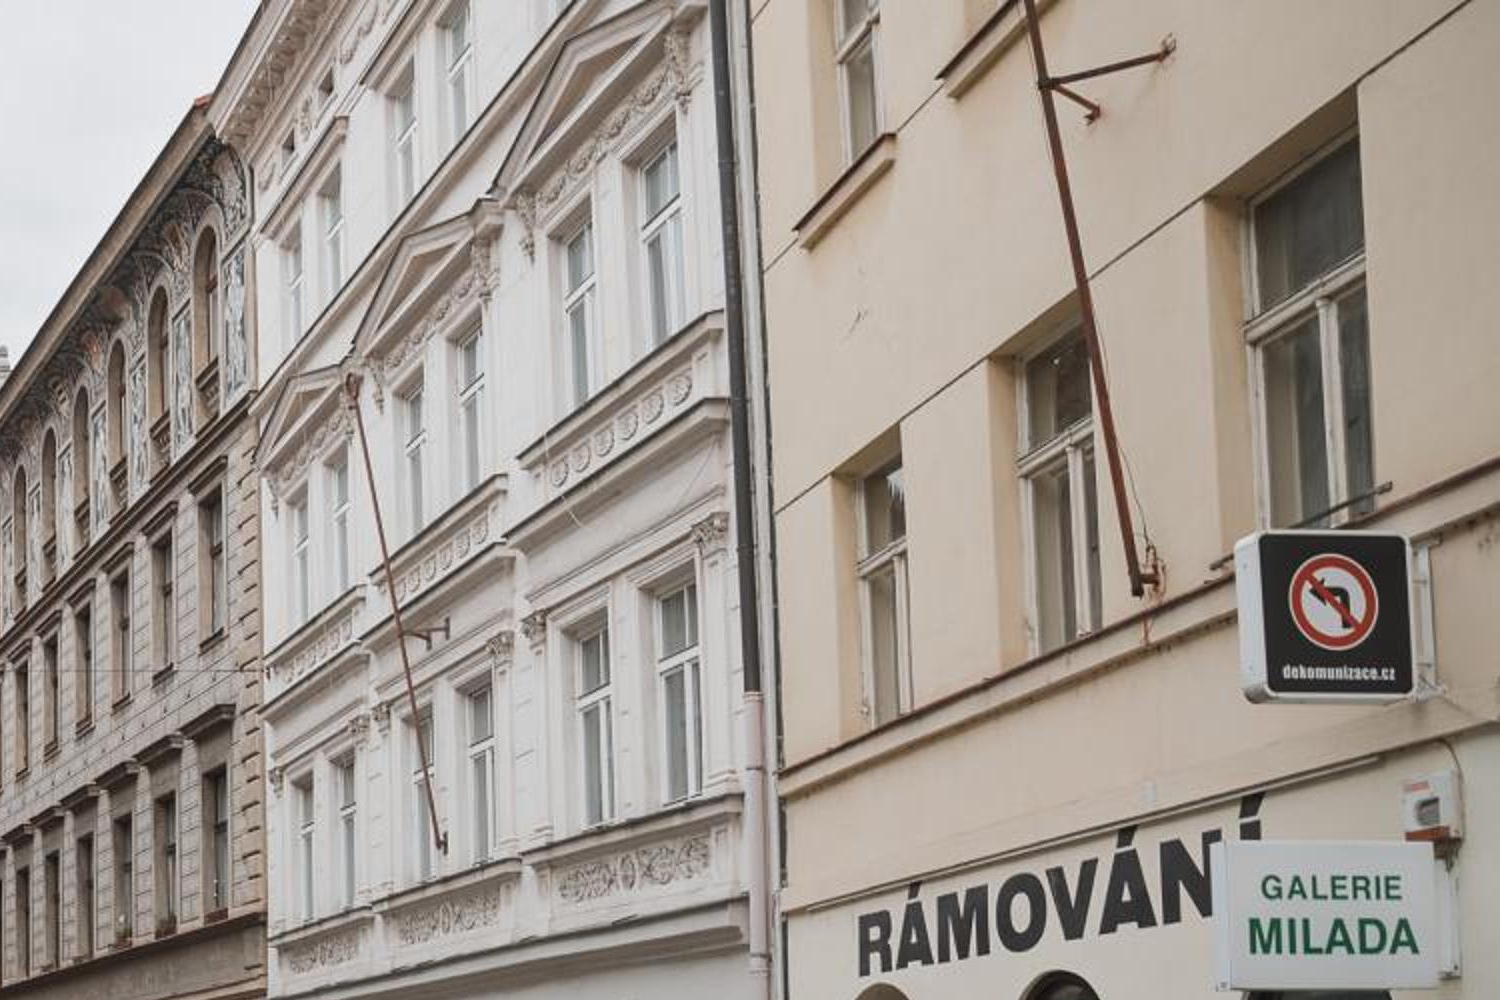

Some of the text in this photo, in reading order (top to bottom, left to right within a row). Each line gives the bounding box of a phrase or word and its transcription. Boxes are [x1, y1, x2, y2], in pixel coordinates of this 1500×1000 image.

[1283, 663, 1395, 681] dekomunizace.cz
[1260, 874, 1402, 901] GALERIE
[1248, 917, 1420, 956] MILADA
